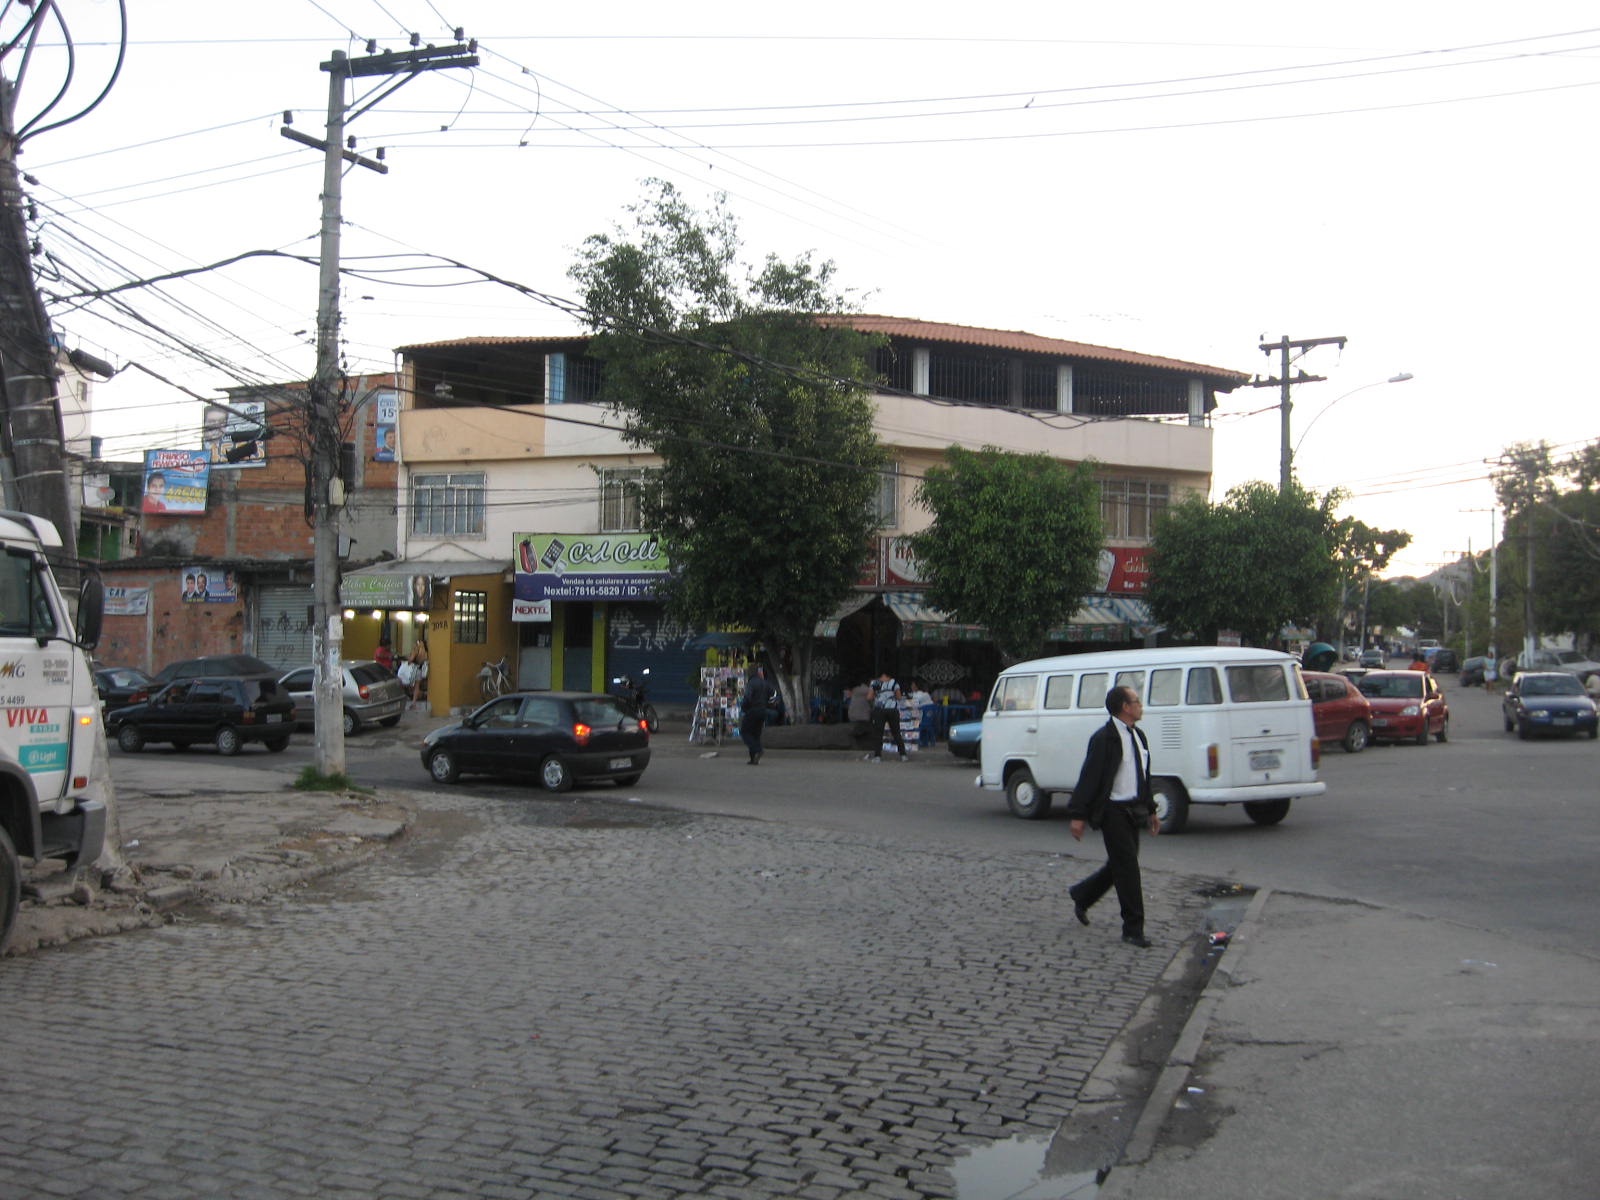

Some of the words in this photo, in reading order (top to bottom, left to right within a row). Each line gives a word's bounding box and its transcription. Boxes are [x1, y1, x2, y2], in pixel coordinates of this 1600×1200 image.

[569, 540, 610, 564] Cid
[613, 540, 660, 564] Cell
[562, 577, 584, 585] Vendas
[595, 577, 623, 585] celulares
[514, 606, 548, 615] NEXTEL
[7, 695, 25, 705] 4499
[7, 708, 49, 728] VIVA
[40, 751, 57, 763] Light
